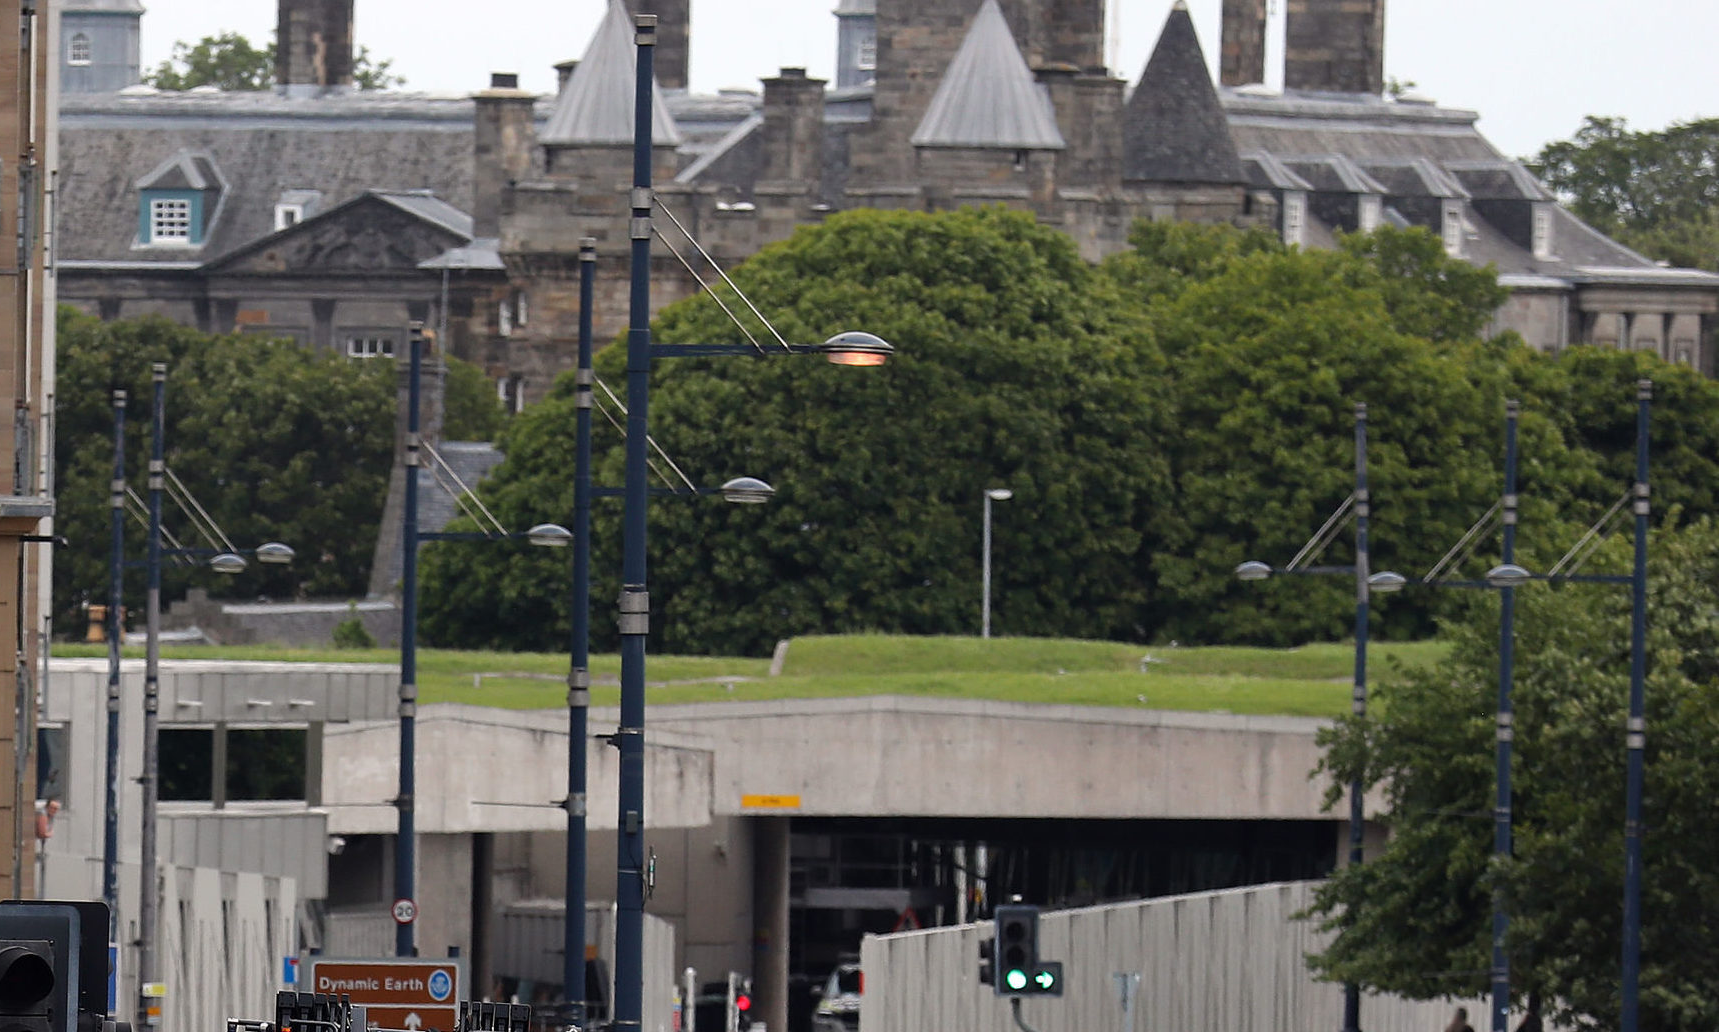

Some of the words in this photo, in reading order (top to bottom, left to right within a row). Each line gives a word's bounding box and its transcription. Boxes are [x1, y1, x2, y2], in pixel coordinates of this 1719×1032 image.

[396, 905, 414, 918] 20
[319, 976, 380, 992] Dynamic
[384, 977, 424, 991] Earth
